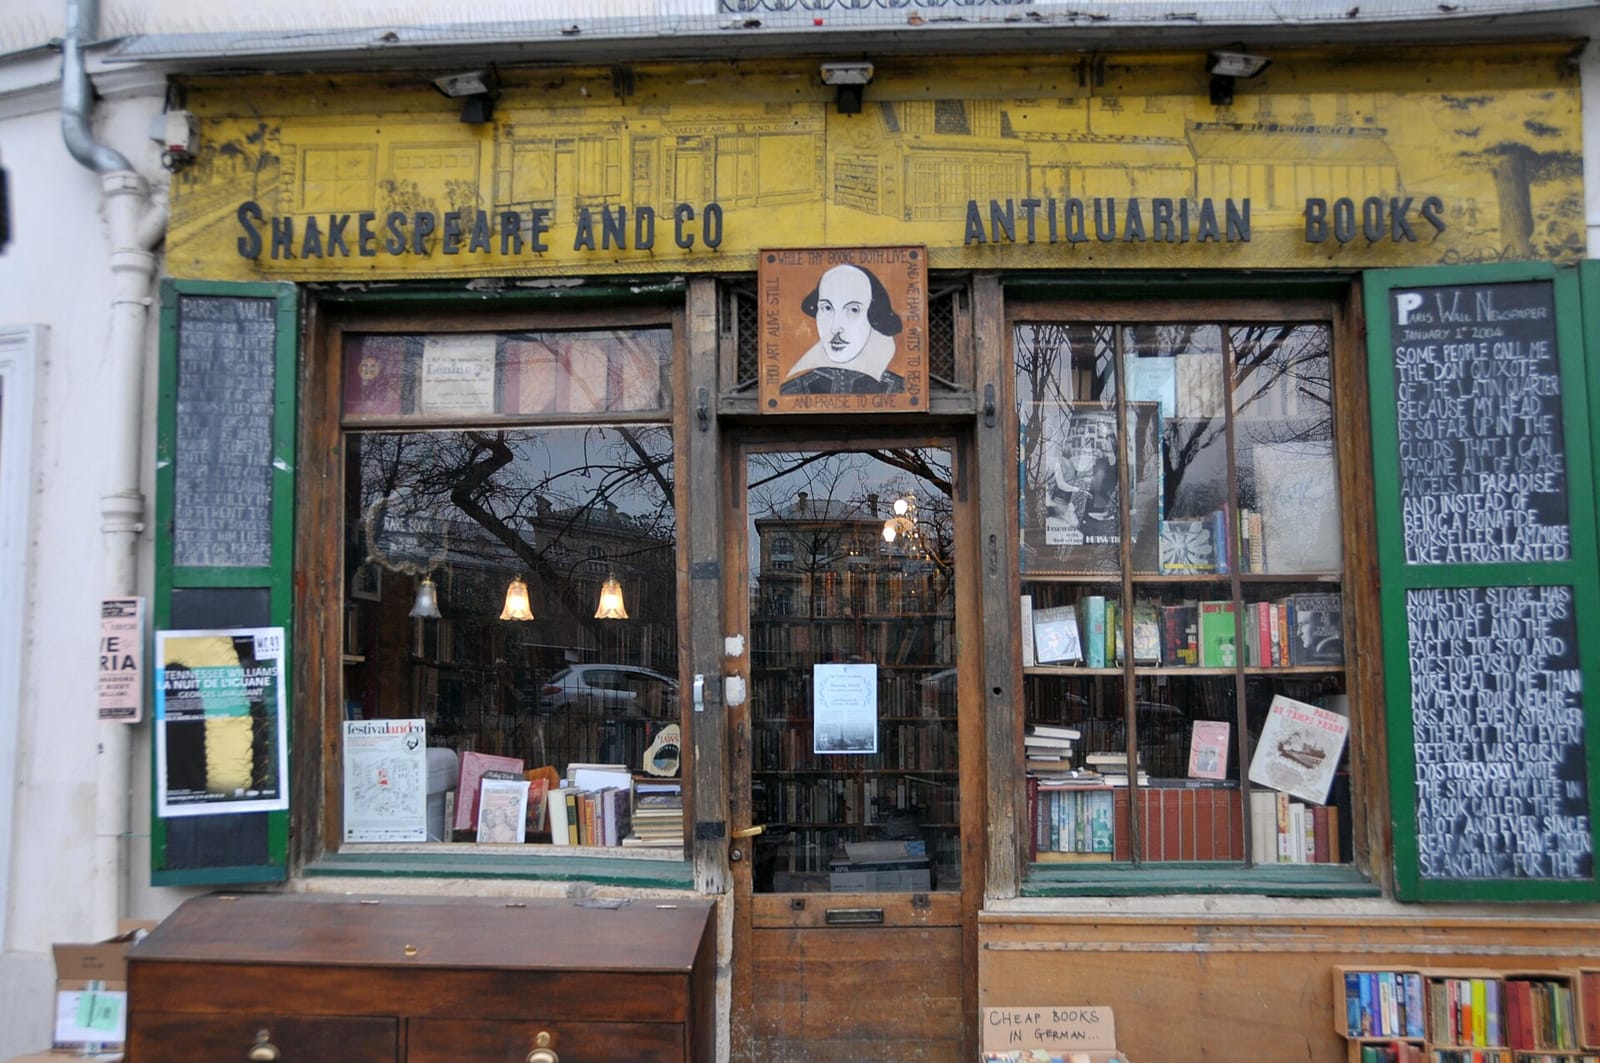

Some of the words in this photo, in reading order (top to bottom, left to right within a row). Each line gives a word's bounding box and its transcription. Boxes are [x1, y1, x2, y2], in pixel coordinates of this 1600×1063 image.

[237, 201, 550, 259] SHAKESPEARE
[573, 206, 656, 251] AND
[674, 203, 724, 249] CO
[965, 196, 1251, 245] ANTIQUARIAN
[1304, 195, 1446, 243] BOOKS
[777, 251, 802, 265] WHILE
[808, 251, 823, 264] THY
[860, 250, 883, 264] DOTH
[887, 250, 908, 263] LIVE
[907, 264, 919, 280] AND
[767, 276, 780, 305] STILL
[908, 281, 920, 292] WE
[182, 301, 218, 319] PARIS
[240, 302, 273, 319] WALL
[907, 294, 920, 321] HAVE
[767, 309, 780, 337] ALIVE
[907, 328, 920, 352] WITS
[1402, 329, 1450, 341] JANUARY
[767, 343, 779, 357] ART
[1396, 346, 1437, 364] SOME
[1443, 344, 1488, 362] PEOPLE
[1493, 342, 1525, 359] CALL
[1529, 341, 1550, 359] ME
[908, 356, 920, 366] TO
[1396, 364, 1428, 382] THE
[1434, 364, 1464, 380] DON
[1471, 360, 1539, 378] QUIXOTE
[767, 364, 780, 385] THOU
[907, 370, 921, 394] READ
[1400, 383, 1416, 401] OF
[1423, 381, 1451, 399] THE
[1458, 378, 1502, 398] LATIN
[1506, 376, 1560, 396] QUARTER
[793, 398, 814, 408] AND
[816, 397, 849, 408] PRAISE
[857, 396, 867, 408] TO
[872, 395, 896, 407] GIVE
[1398, 399, 1466, 420] BECAUSE
[1473, 398, 1492, 417] MY
[1501, 396, 1541, 415] HEAD
[1399, 421, 1411, 440] IS
[1415, 421, 1433, 440] SO
[1438, 419, 1469, 438] FAR
[1473, 417, 1494, 436] UP
[1497, 417, 1512, 435] IN
[1520, 415, 1552, 435] THE
[1400, 440, 1453, 460] CLOUDS
[1459, 438, 1499, 457] THAT
[1505, 437, 1511, 456] I
[1518, 437, 1550, 456] CAN
[1401, 459, 1456, 476] IMAGINE
[1463, 459, 1489, 474] ALL
[1494, 457, 1510, 473] OF
[1515, 456, 1533, 472] US
[1537, 454, 1563, 473] ARE
[1401, 477, 1457, 495] ANGELS
[1462, 477, 1474, 493] IN
[1480, 473, 1560, 493] PARADISE.
[1403, 496, 1436, 514] AND
[1441, 494, 1506, 512] INSTEAD
[1512, 493, 1530, 509] OF
[1403, 513, 1448, 532] BEING
[1452, 513, 1461, 529] A
[1468, 510, 1537, 529] BONAFIDE
[1405, 530, 1493, 547] BOOKSELLER
[1502, 529, 1507, 545] I
[1515, 527, 1535, 544] AM
[1536, 526, 1569, 543] MORE
[1405, 546, 1441, 564] LIKE
[1447, 546, 1457, 562] A
[1461, 543, 1567, 561] FRUSTRATED
[1407, 588, 1479, 606] NOVELIST
[1485, 587, 1535, 604] STORE
[1540, 586, 1570, 602] HAS
[1407, 604, 1449, 621] ROOMS
[1452, 603, 1485, 620] LIKE
[1491, 602, 1567, 620] CHAPTERS
[1408, 621, 1422, 640] IN
[1424, 622, 1435, 641] A
[1438, 620, 1484, 639] NOVEL
[1491, 619, 1520, 639] AND
[1522, 618, 1552, 638] THE
[1408, 640, 1441, 657] FACT
[1452, 639, 1463, 656] IS
[1532, 637, 1565, 655] AND
[164, 669, 225, 680] TENNESSEE
[227, 667, 277, 677] WILLIAMS
[1518, 655, 1545, 673] ARE
[174, 680, 200, 689] NUIT
[1411, 673, 1445, 692] MORE
[1451, 672, 1486, 692] REAL
[1491, 672, 1512, 691] TO
[1516, 670, 1537, 691] ME
[1541, 669, 1580, 691] THAN
[1412, 691, 1430, 709] MY
[1435, 690, 1474, 708] NEXT
[1477, 691, 1511, 708] DOOR
[1412, 708, 1437, 725] ORS
[1443, 708, 1471, 725] AND
[1476, 707, 1515, 724] EVEN
[1414, 725, 1425, 743] IS
[1427, 724, 1453, 743] THE
[1455, 724, 1486, 742] FACT
[1495, 724, 1533, 742] THAT
[1539, 724, 1580, 744] EVEN
[1414, 743, 1469, 762] BEFORE
[1472, 743, 1478, 761] I
[1484, 743, 1516, 761] WAS
[1518, 743, 1562, 762] BORN
[1512, 762, 1557, 780] WROTE
[1415, 781, 1442, 799] THE
[1447, 780, 1488, 798] STORY
[1492, 781, 1509, 796] OF
[1511, 781, 1529, 796] MY
[1533, 780, 1561, 796] LIFE
[1566, 780, 1581, 798] IN
[1417, 800, 1429, 817] A
[1431, 798, 1468, 816] BOOK
[1472, 798, 1523, 816] CALLED
[1464, 816, 1497, 834] AND
[1501, 816, 1537, 832] EVER
[1543, 816, 1587, 832] SINCE
[1513, 853, 1544, 876] FOR
[1547, 853, 1581, 876] THE
[990, 1011, 1041, 1025] CHEAP
[1053, 1011, 1099, 1024] BOOKS
[1010, 1029, 1022, 1043] IN
